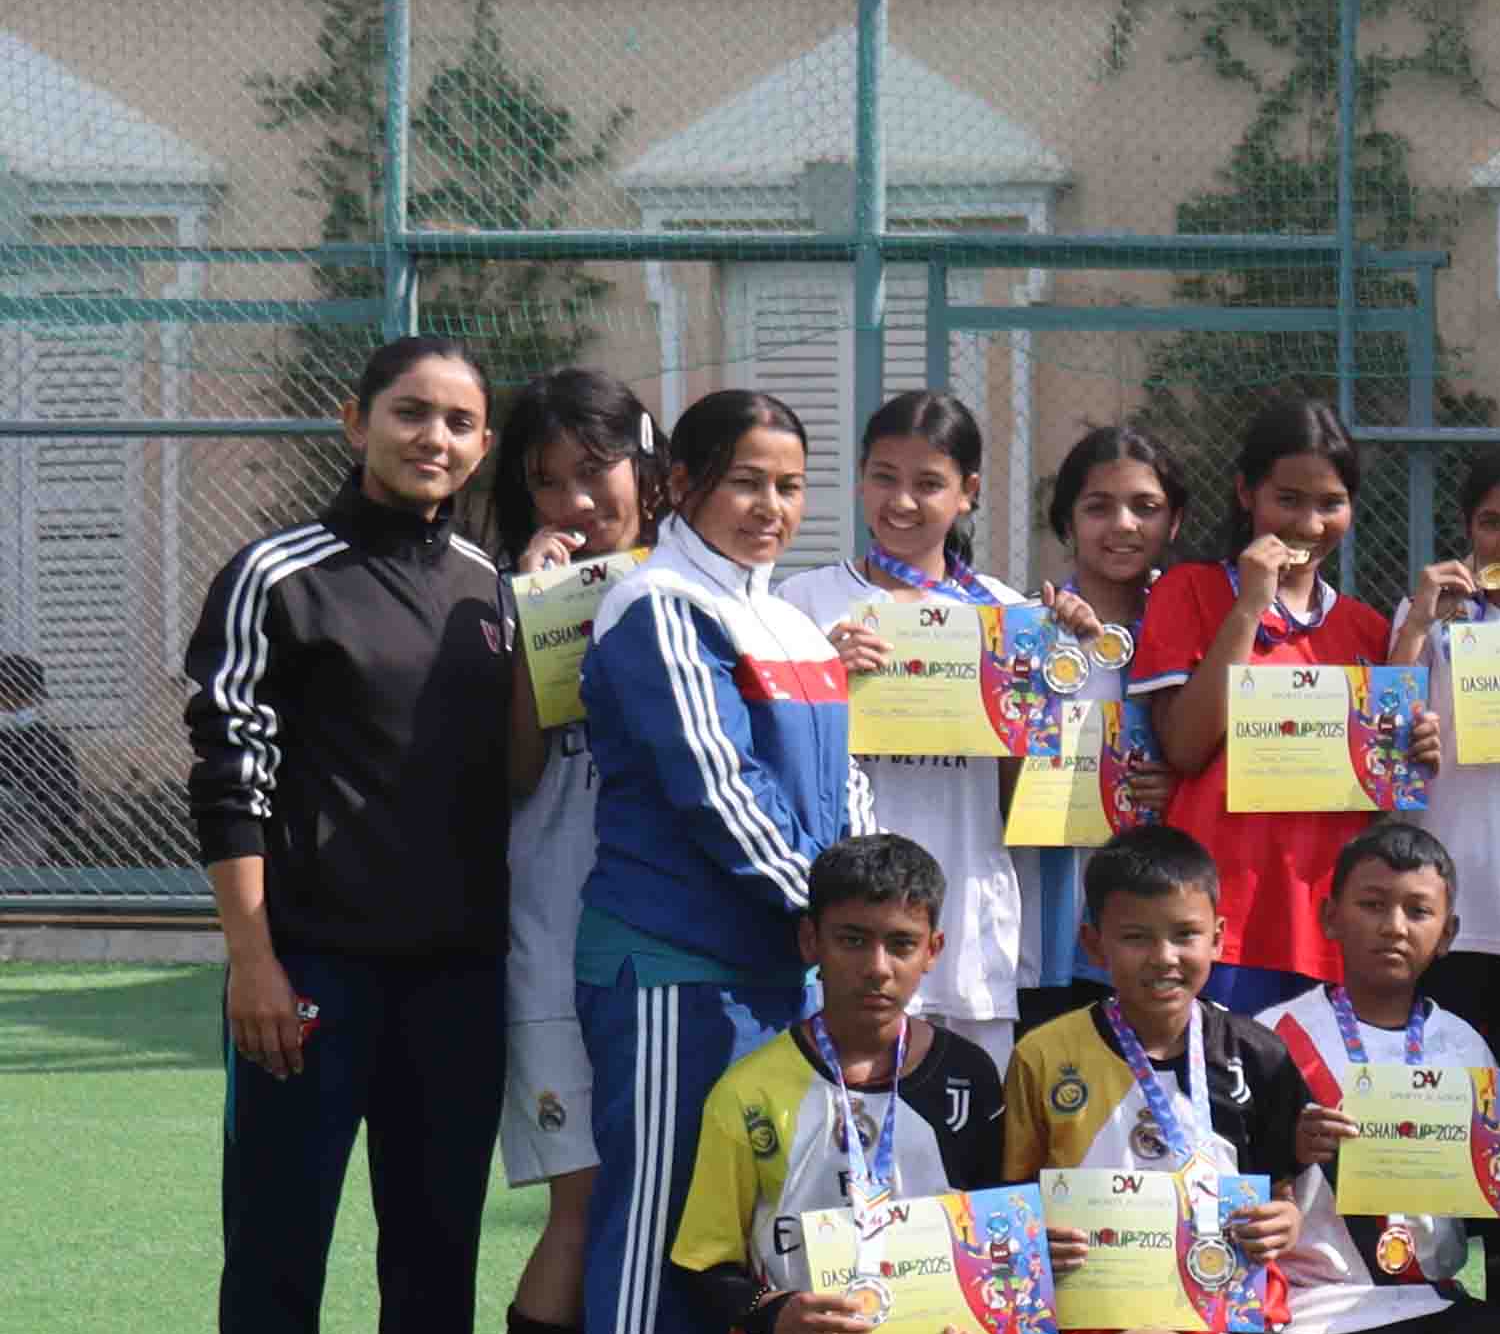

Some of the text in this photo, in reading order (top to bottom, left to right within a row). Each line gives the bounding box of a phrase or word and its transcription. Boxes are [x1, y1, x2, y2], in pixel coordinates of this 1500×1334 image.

[581, 561, 608, 587] DAV
[919, 608, 951, 627] DAV
[910, 658, 976, 679] UP-2025
[1293, 671, 1320, 689] DAV
[1236, 719, 1345, 738] DASHAIN UP-2025
[1413, 1071, 1442, 1088] DAV
[1400, 1119, 1468, 1141] UP-2025
[1112, 1176, 1143, 1193] DAV
[1100, 1228, 1172, 1250] UP-2025
[822, 1258, 951, 1287] DASH UP-2025
